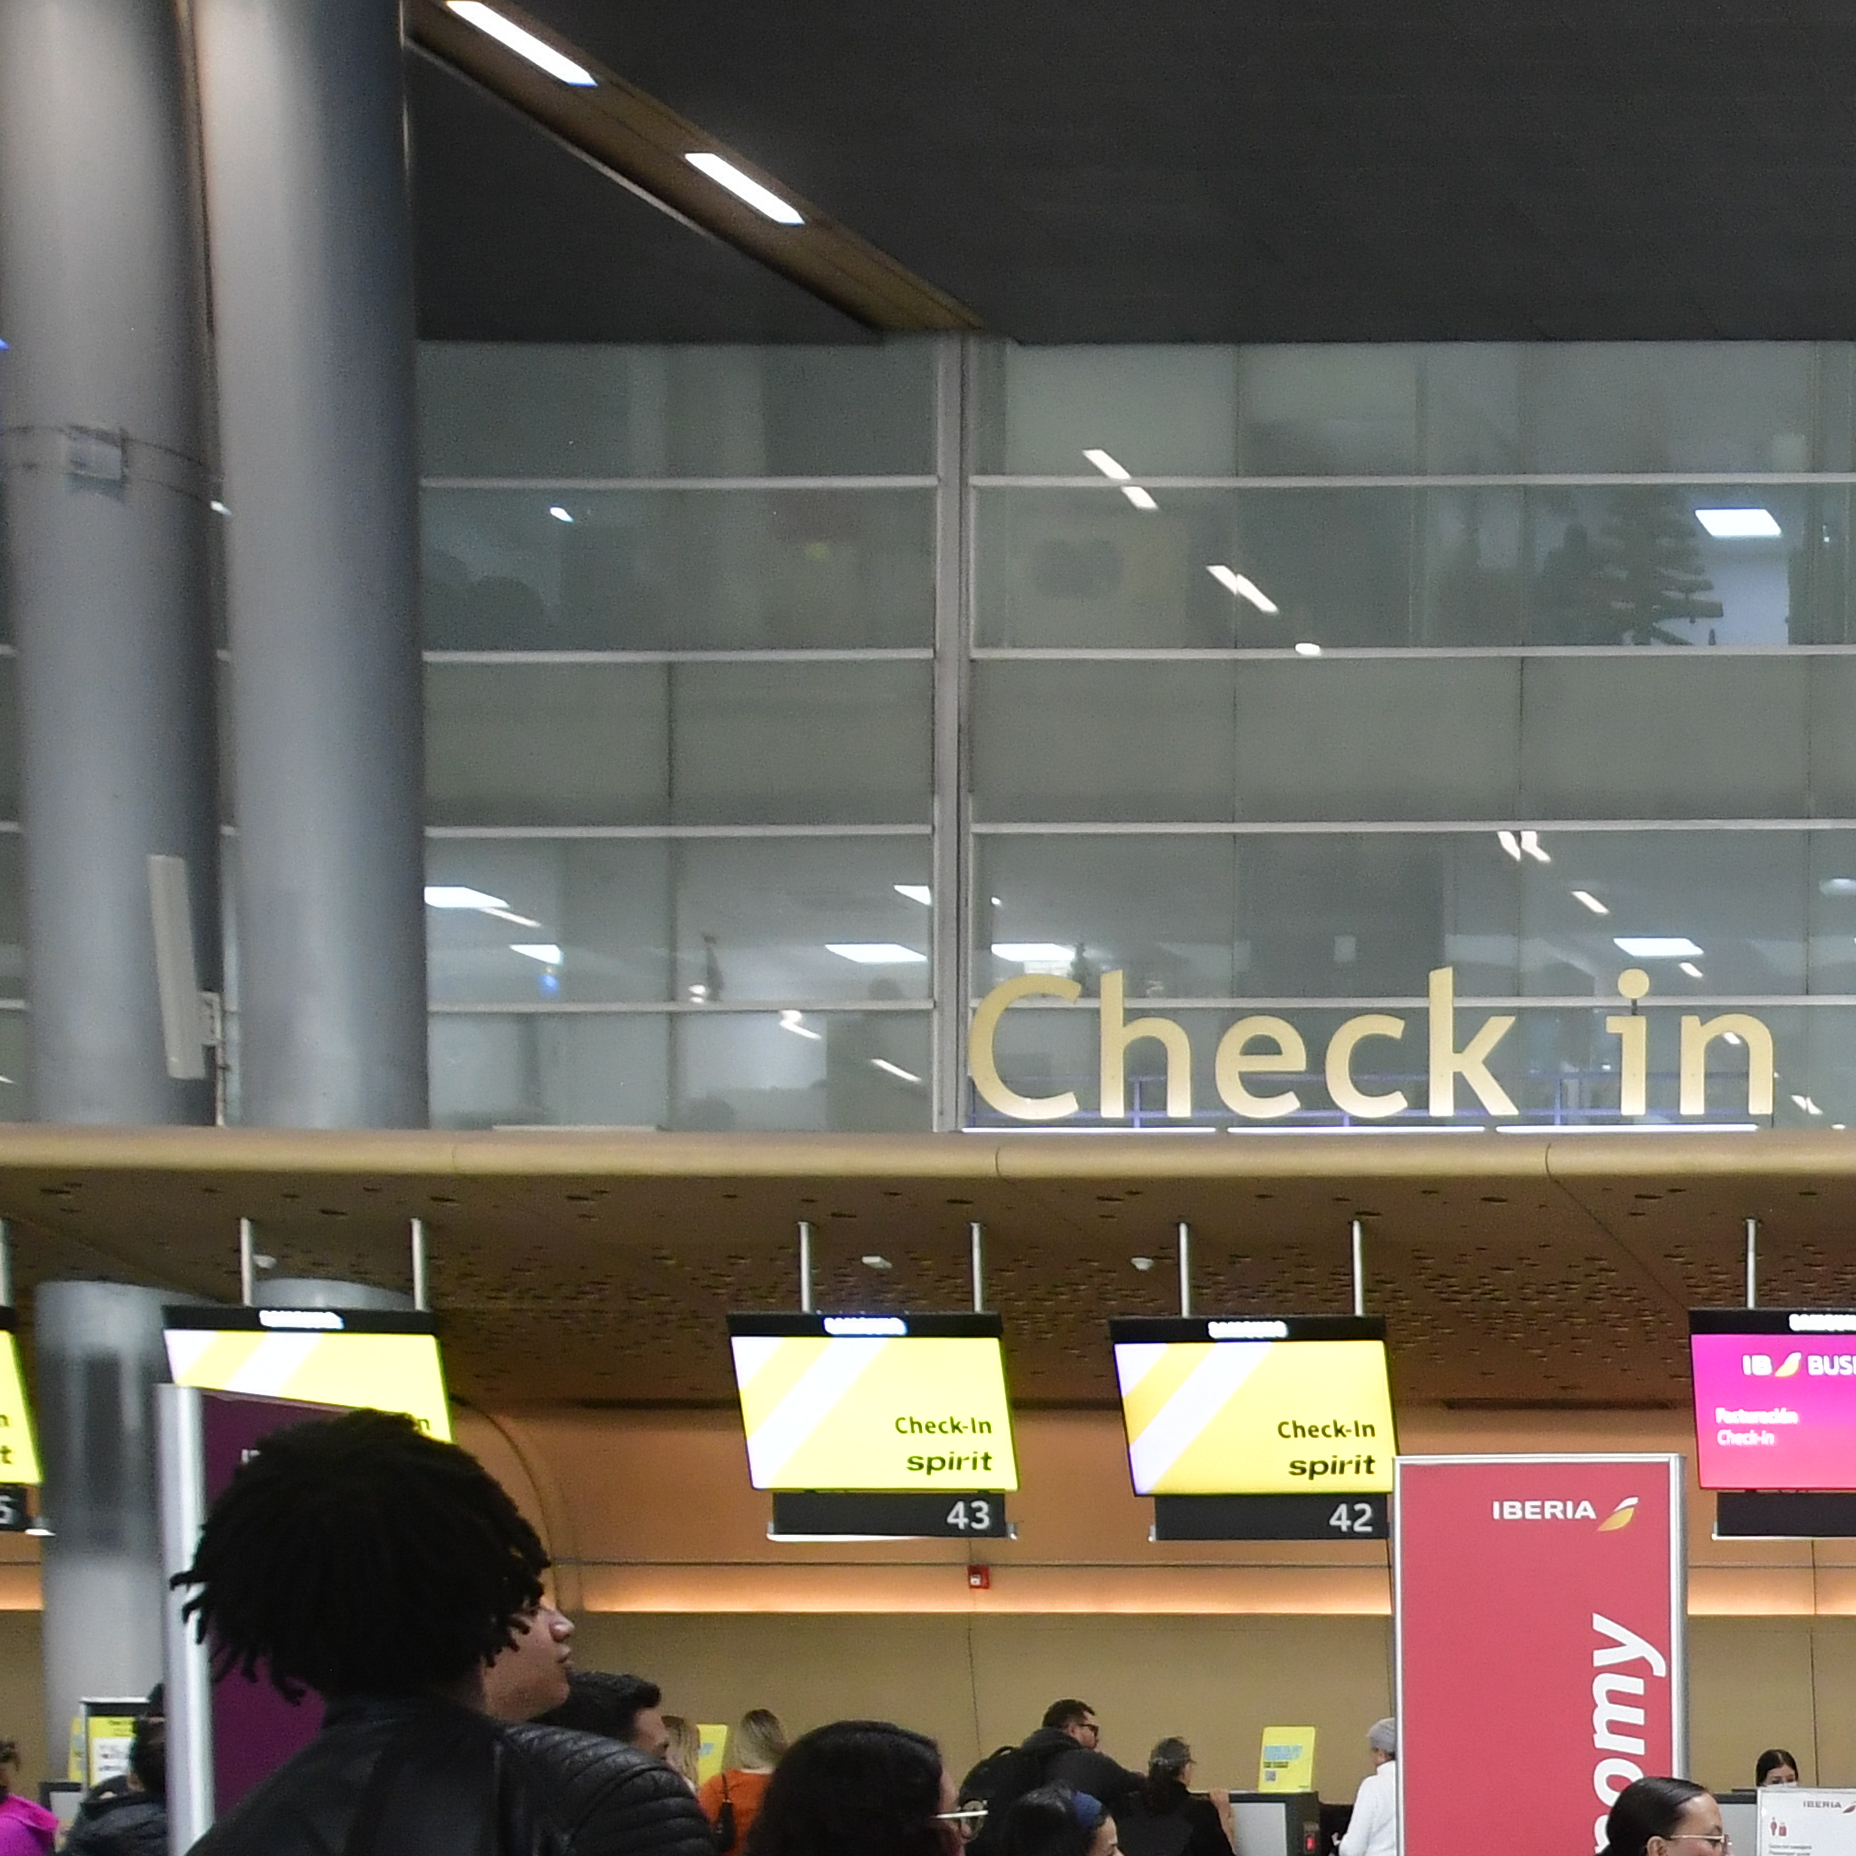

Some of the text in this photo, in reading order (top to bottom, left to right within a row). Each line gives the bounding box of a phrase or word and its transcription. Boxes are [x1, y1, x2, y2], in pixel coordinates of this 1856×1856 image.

[967, 967, 1774, 1120] Check in
[1743, 1355, 1772, 1375] IB
[895, 1417, 992, 1434] Check-In
[1278, 1420, 1375, 1438] Check-In
[1717, 1430, 1774, 1445] Check-in
[907, 1452, 992, 1475] spirit
[1289, 1455, 1375, 1480] spirit
[947, 1501, 989, 1530] 43
[1329, 1503, 1373, 1532] 42
[1493, 1501, 1596, 1519] IBERIA
